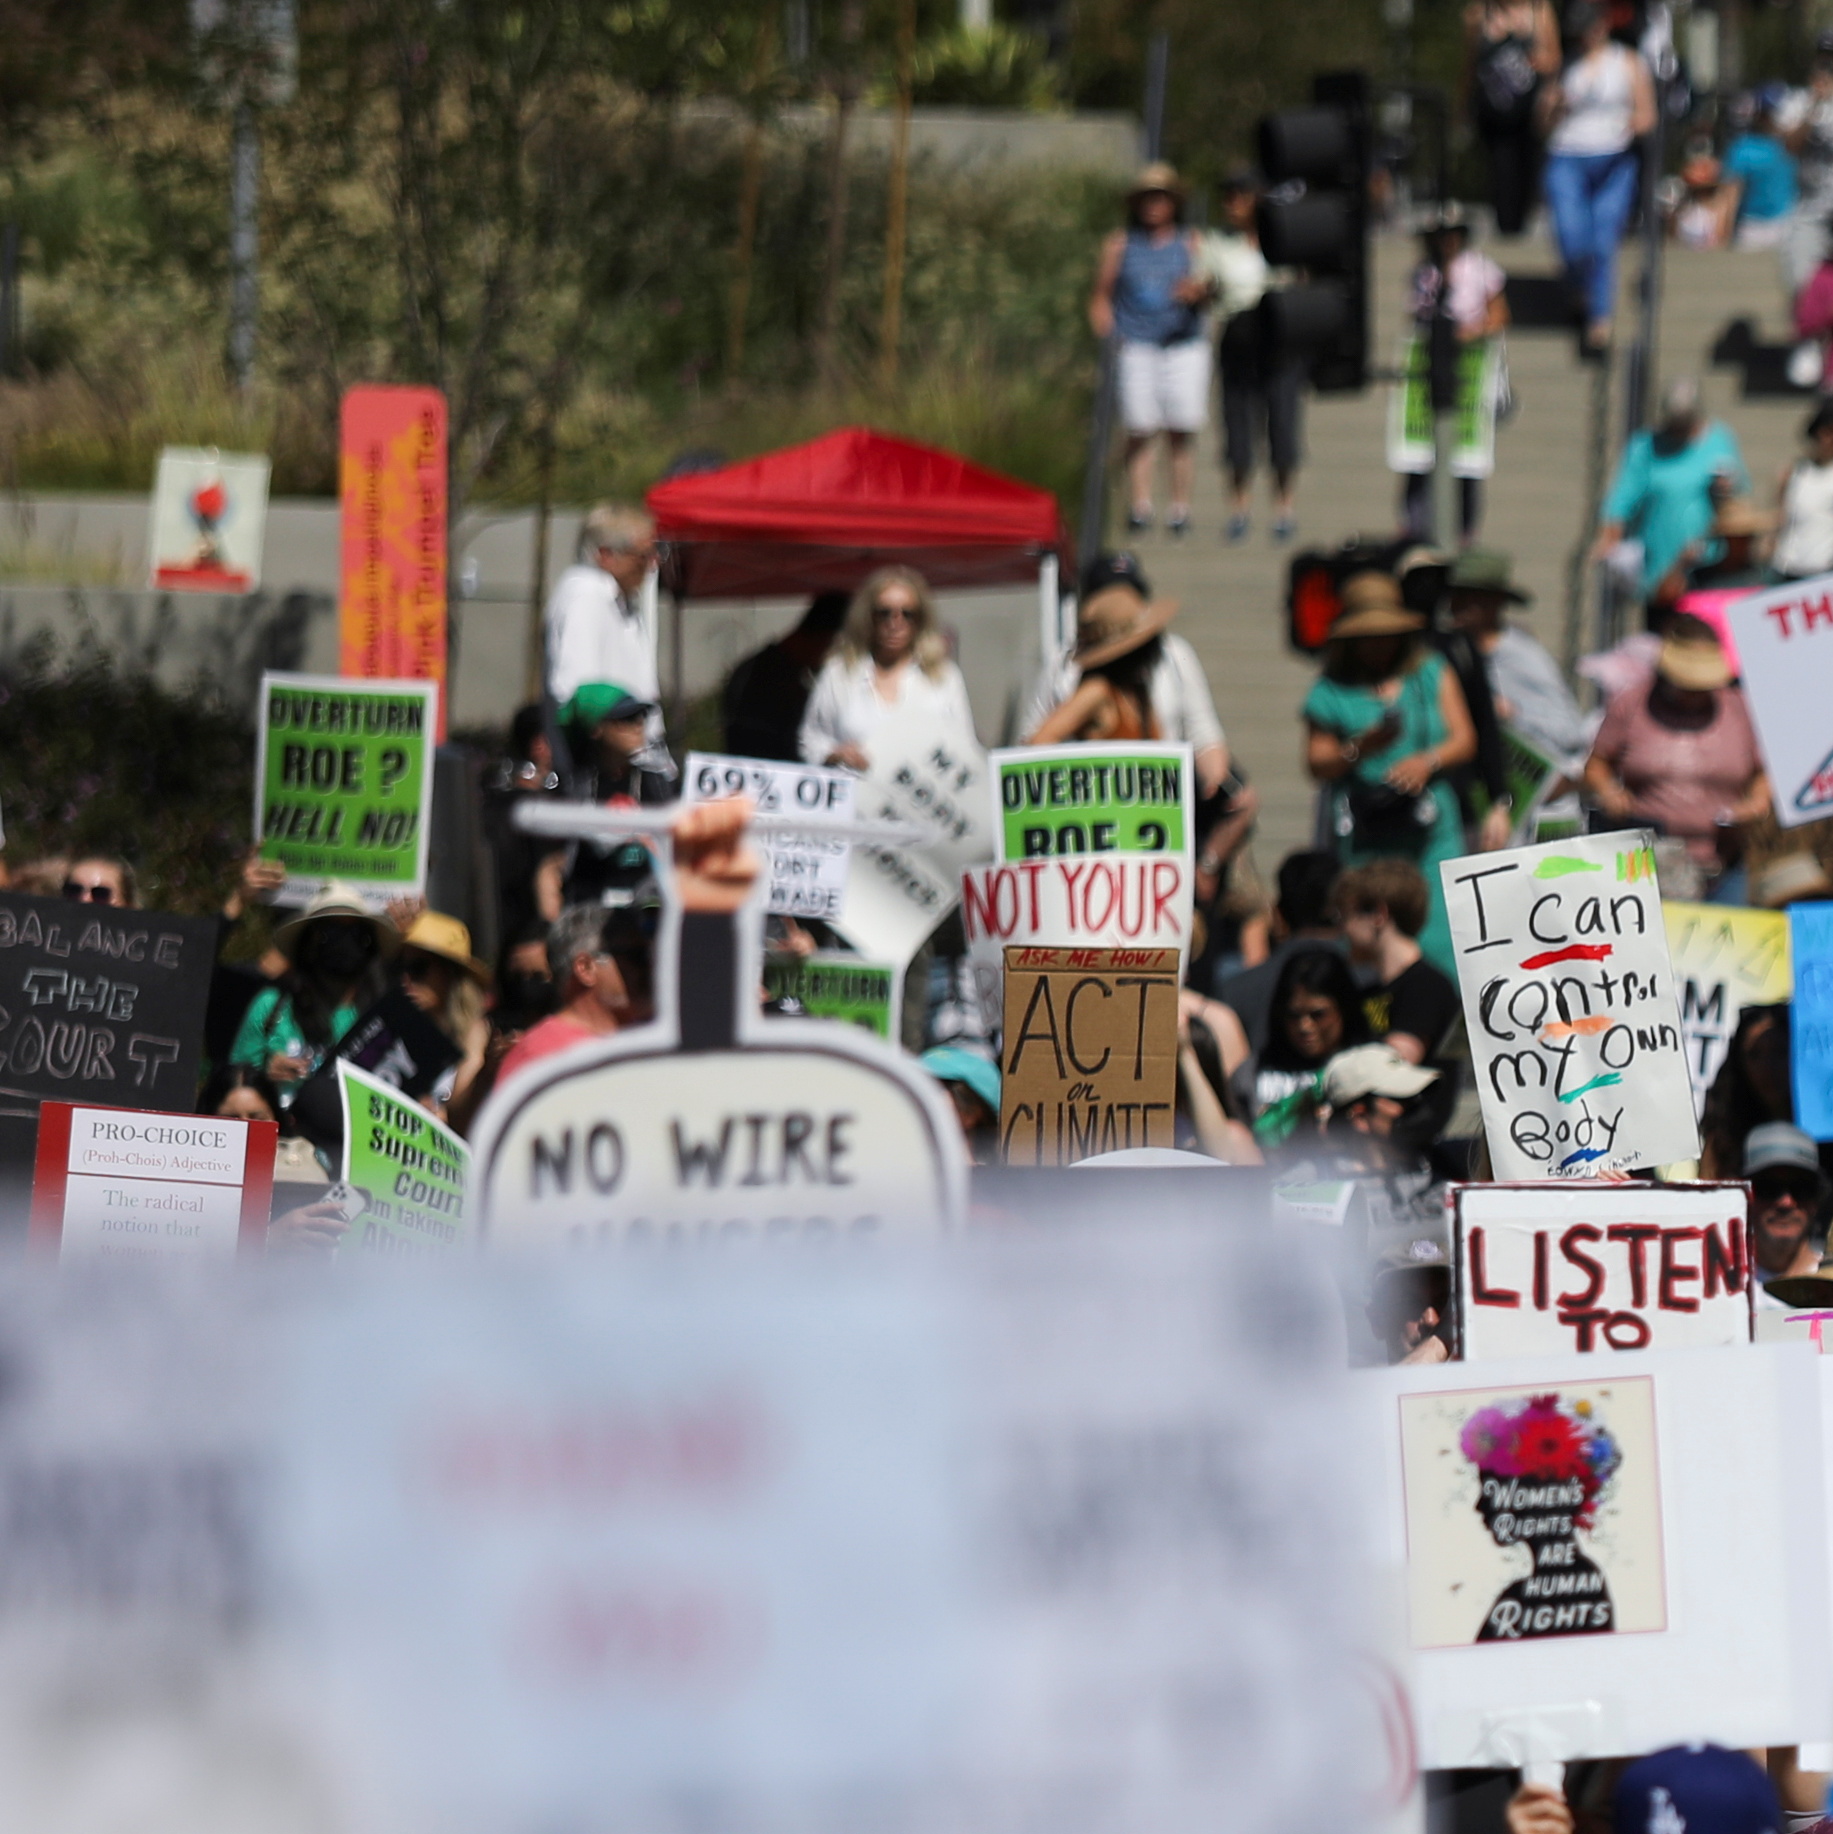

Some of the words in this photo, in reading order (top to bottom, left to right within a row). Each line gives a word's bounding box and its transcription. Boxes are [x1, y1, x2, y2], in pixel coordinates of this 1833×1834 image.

[268, 697, 426, 738] OVERTURN
[282, 744, 367, 796] ROE
[378, 747, 410, 796] ?
[1002, 765, 1181, 810] OVERTURN
[264, 804, 347, 850] HELL
[356, 806, 420, 852] NO!
[963, 862, 1048, 939] NOT
[1057, 862, 1181, 940] YOUR
[1455, 862, 1519, 954] I
[0, 911, 185, 967] BALANCE
[1018, 948, 1059, 968] ASK
[1067, 949, 1099, 969] ME
[1109, 949, 1167, 970] HOW!
[23, 964, 139, 1023] THE
[1007, 975, 1175, 1081] ACT
[1067, 1081, 1101, 1103] on
[368, 1092, 425, 1135] STOP
[91, 1121, 229, 1150] PRO-CHOICE
[530, 1120, 634, 1200] NO
[671, 1110, 860, 1190] WIRE
[82, 1148, 169, 1171] (Proh-Chois)
[170, 1154, 233, 1174] Adjective
[102, 1188, 140, 1208] The
[143, 1192, 205, 1214] radical
[101, 1215, 159, 1235] notion
[165, 1219, 202, 1239] that
[1468, 1217, 1746, 1313] LISTEN
[1557, 1308, 1652, 1353] TO
[1482, 1477, 1586, 1512] WOMEN'S
[1494, 1512, 1574, 1543] RIGHTS
[1540, 1542, 1576, 1568] ARE
[1524, 1573, 1605, 1600] HUMAN
[1490, 1599, 1613, 1640] RIGHTS
